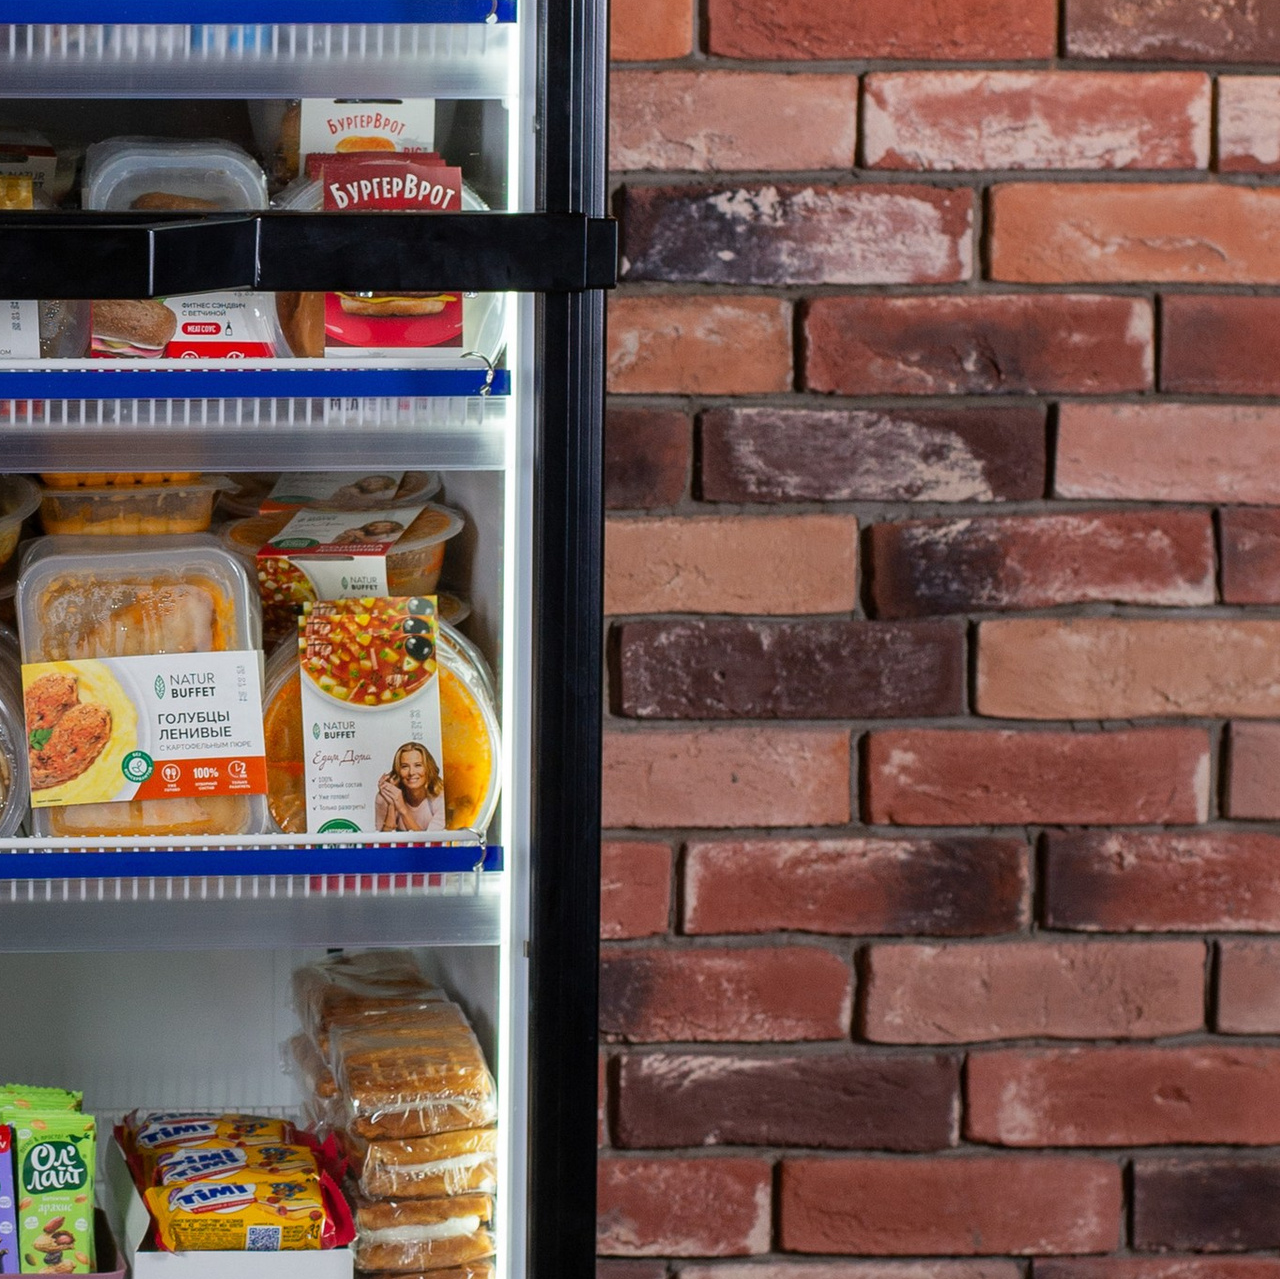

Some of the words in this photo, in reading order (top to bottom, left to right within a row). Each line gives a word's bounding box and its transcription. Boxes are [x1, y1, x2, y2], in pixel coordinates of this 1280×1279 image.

[188, 309, 226, 317] ВЕТЧИНОЙ
[350, 576, 377, 584] NATUR
[170, 672, 215, 686] NATUR
[171, 686, 216, 699] BUFFET
[158, 711, 230, 725] ГОЛУБЦЫ
[323, 721, 356, 730] NATUR
[159, 726, 232, 741] ЛЕНИВЫЕ
[324, 730, 356, 739] BUFFET
[166, 742, 229, 751] КАРТОФЕЛЬНЫМ
[229, 740, 252, 748] ПЮРЕ
[193, 767, 219, 779] 100%
[26, 1166, 85, 1191] лайт
[38, 1203, 72, 1215] арахис
